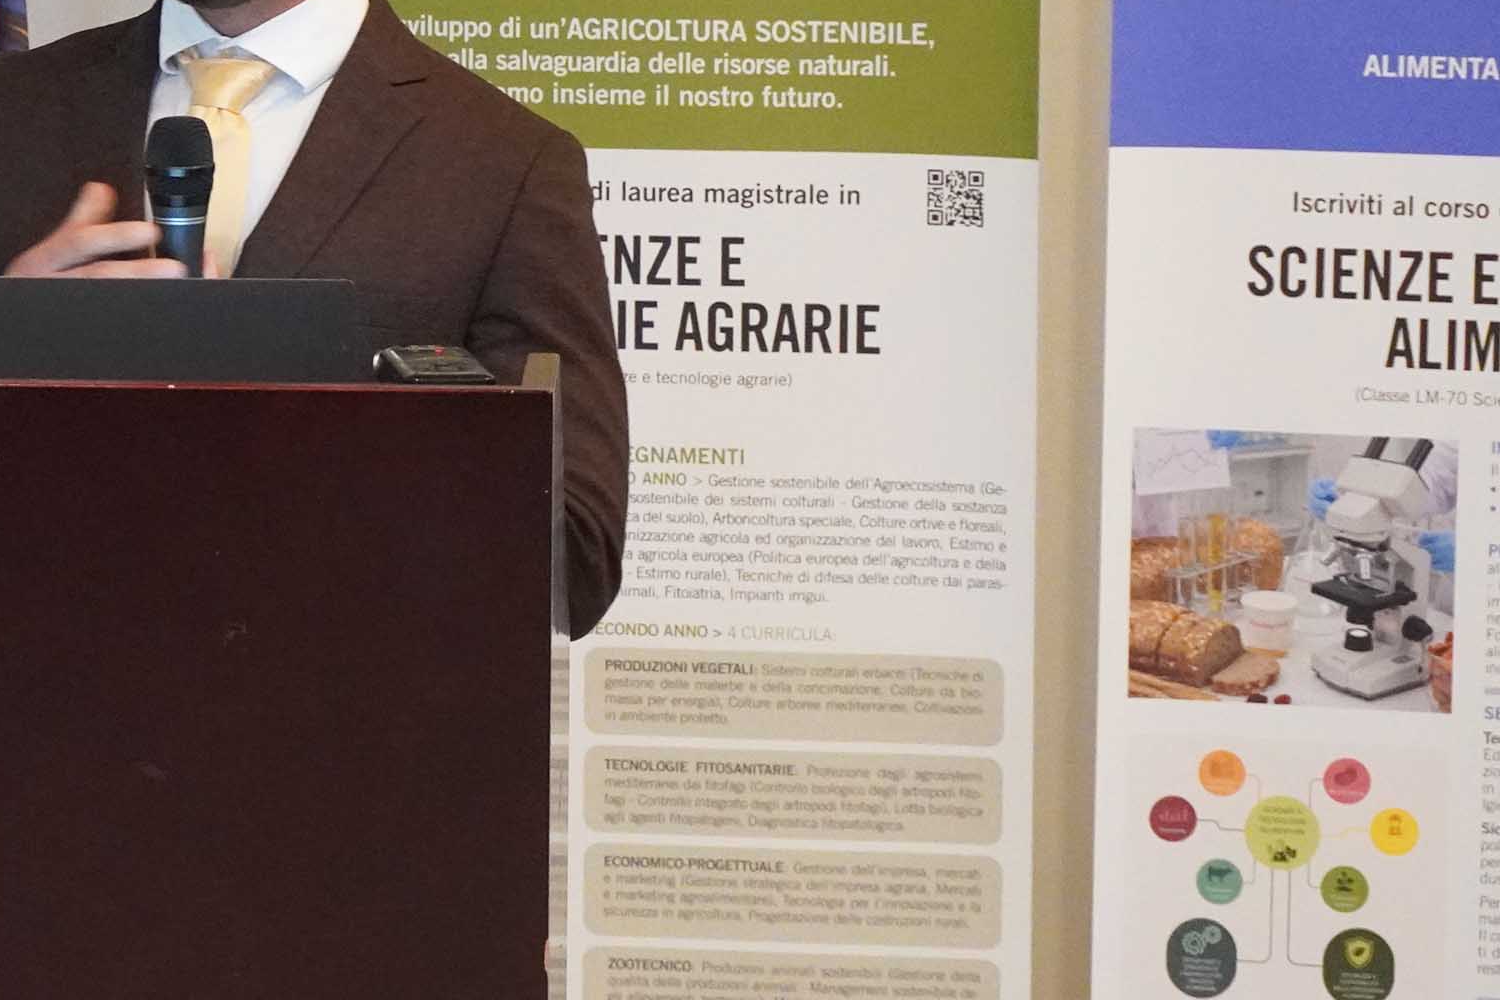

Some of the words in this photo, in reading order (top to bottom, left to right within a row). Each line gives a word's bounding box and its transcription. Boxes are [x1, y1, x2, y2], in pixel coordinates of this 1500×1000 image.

[500, 16, 521, 38] di
[530, 17, 747, 42] un'AGRICOLTURA
[755, 19, 935, 49] SOSTENIBILE,
[495, 49, 640, 76] salvaguardia
[648, 52, 705, 74] delle
[713, 53, 790, 76] risorse
[799, 55, 896, 78] naturali.
[552, 82, 646, 106] insieme
[655, 84, 669, 106] il
[678, 85, 754, 107] nostro
[762, 86, 843, 109] futuro.
[592, 181, 611, 201] di
[621, 181, 694, 203] laurea
[704, 183, 829, 208] magistrale
[839, 184, 861, 205] in
[1293, 191, 1383, 216] Iscriviti
[1392, 195, 1414, 217] al
[1424, 200, 1490, 219] corso
[598, 234, 702, 286] NZE
[720, 236, 746, 287] E
[1247, 245, 1454, 304] SCIENZE
[1473, 253, 1499, 306] E
[674, 300, 881, 355] AGRARIE
[642, 373, 651, 384] e
[656, 370, 733, 389] tecnologie
[736, 371, 793, 389] agrarie)
[1415, 389, 1467, 406] LM-70
[642, 472, 687, 487] ANNO
[708, 473, 765, 488] Gestione
[770, 475, 840, 490] sostenibile
[628, 492, 699, 505] sostenibile
[704, 494, 724, 506] dei
[730, 495, 777, 507] sistemi
[782, 496, 835, 509] colturali
[851, 496, 909, 510] Gestione
[914, 498, 947, 512] della
[951, 502, 1008, 515] sostanza
[643, 511, 663, 523] del
[665, 511, 709, 527] suolo),
[712, 512, 796, 528] Arboricoltura
[859, 515, 907, 530] Colture
[909, 518, 947, 531] ortive
[947, 521, 956, 532] e
[700, 532, 750, 546] agricola
[755, 533, 771, 545] ed
[776, 534, 871, 549] organizzazione
[875, 535, 896, 546] del
[950, 537, 995, 552] Estimo
[998, 541, 1007, 552] e
[637, 549, 688, 564] agricola
[692, 553, 744, 564] europea
[749, 550, 802, 566] (Politica
[806, 554, 858, 567] europea
[963, 559, 971, 569] e
[975, 557, 1007, 572] della
[636, 566, 681, 581] Estimo
[735, 568, 793, 583] Tecniche
[798, 570, 810, 584] di
[814, 571, 854, 585] difesa
[858, 572, 890, 585] delle
[893, 574, 939, 588] colture
[942, 575, 962, 588] dai
[591, 622, 659, 637] ECONDO
[663, 623, 709, 638] ANNO
[727, 625, 737, 639] 4
[604, 659, 688, 673] PRODUZIONI
[604, 758, 688, 773] TECNOLOGIE
